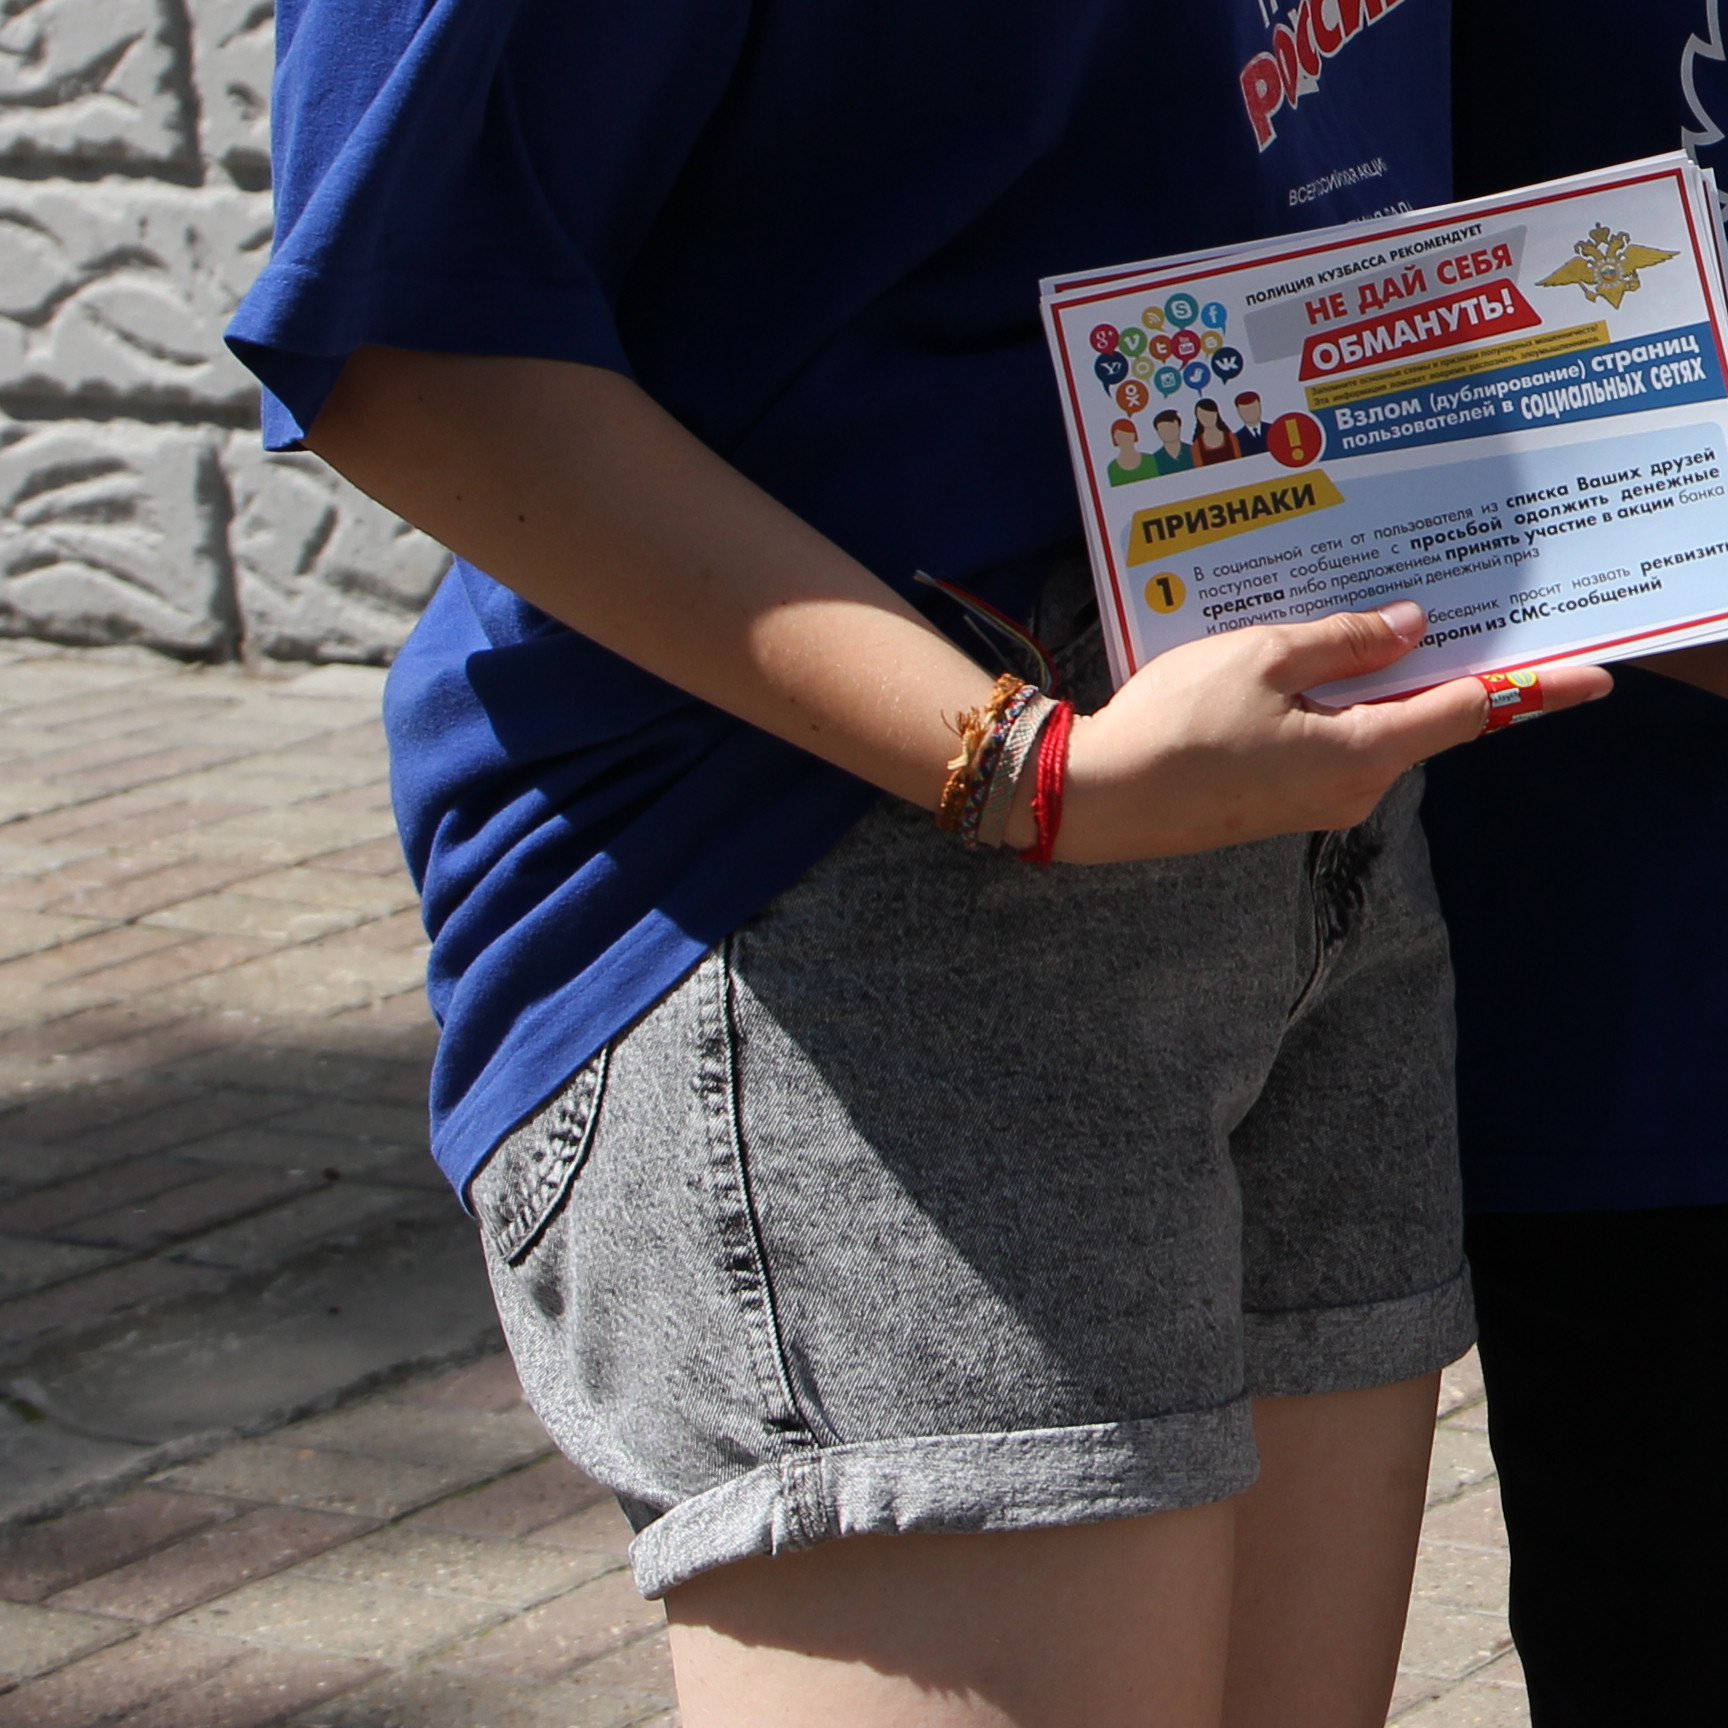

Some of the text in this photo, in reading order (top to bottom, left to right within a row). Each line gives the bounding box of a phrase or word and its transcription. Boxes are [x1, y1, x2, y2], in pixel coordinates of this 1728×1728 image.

[1245, 223, 1482, 306] ПОЛИЦИЯ КУЗБАССА РЕКОМЕНДУЕТ
[1304, 243, 1513, 325] НЕ ДАЙ СЕБЯ
[1312, 287, 1515, 371] ОБМАНУТЬ!
[1334, 398, 1422, 431] Взлом
[1430, 359, 1586, 412] (дублирование)
[1591, 334, 1700, 373] страниц
[1342, 400, 1496, 450] пользователей
[1501, 400, 1514, 413] в
[1520, 370, 1647, 420] социальных
[1650, 356, 1707, 390] сетях
[1142, 483, 1316, 544] ПРИЗНАКИ
[1155, 450, 1716, 607] 1 В социальной сети от пользователя из списка Ваших друзей
[1198, 467, 1720, 600] поступает сообщение с просьбой одолжить денежные
[1202, 485, 1725, 621] средства либо предложением принять участие в акции банка
[1206, 547, 1541, 635] и получить гарантированный денежный приз
[1428, 599, 1501, 624] беседник
[1509, 583, 1561, 606] просит
[1571, 568, 1631, 590] назвать
[1485, 616, 1507, 631] из
[1509, 576, 1662, 625] СМС-сообщений
